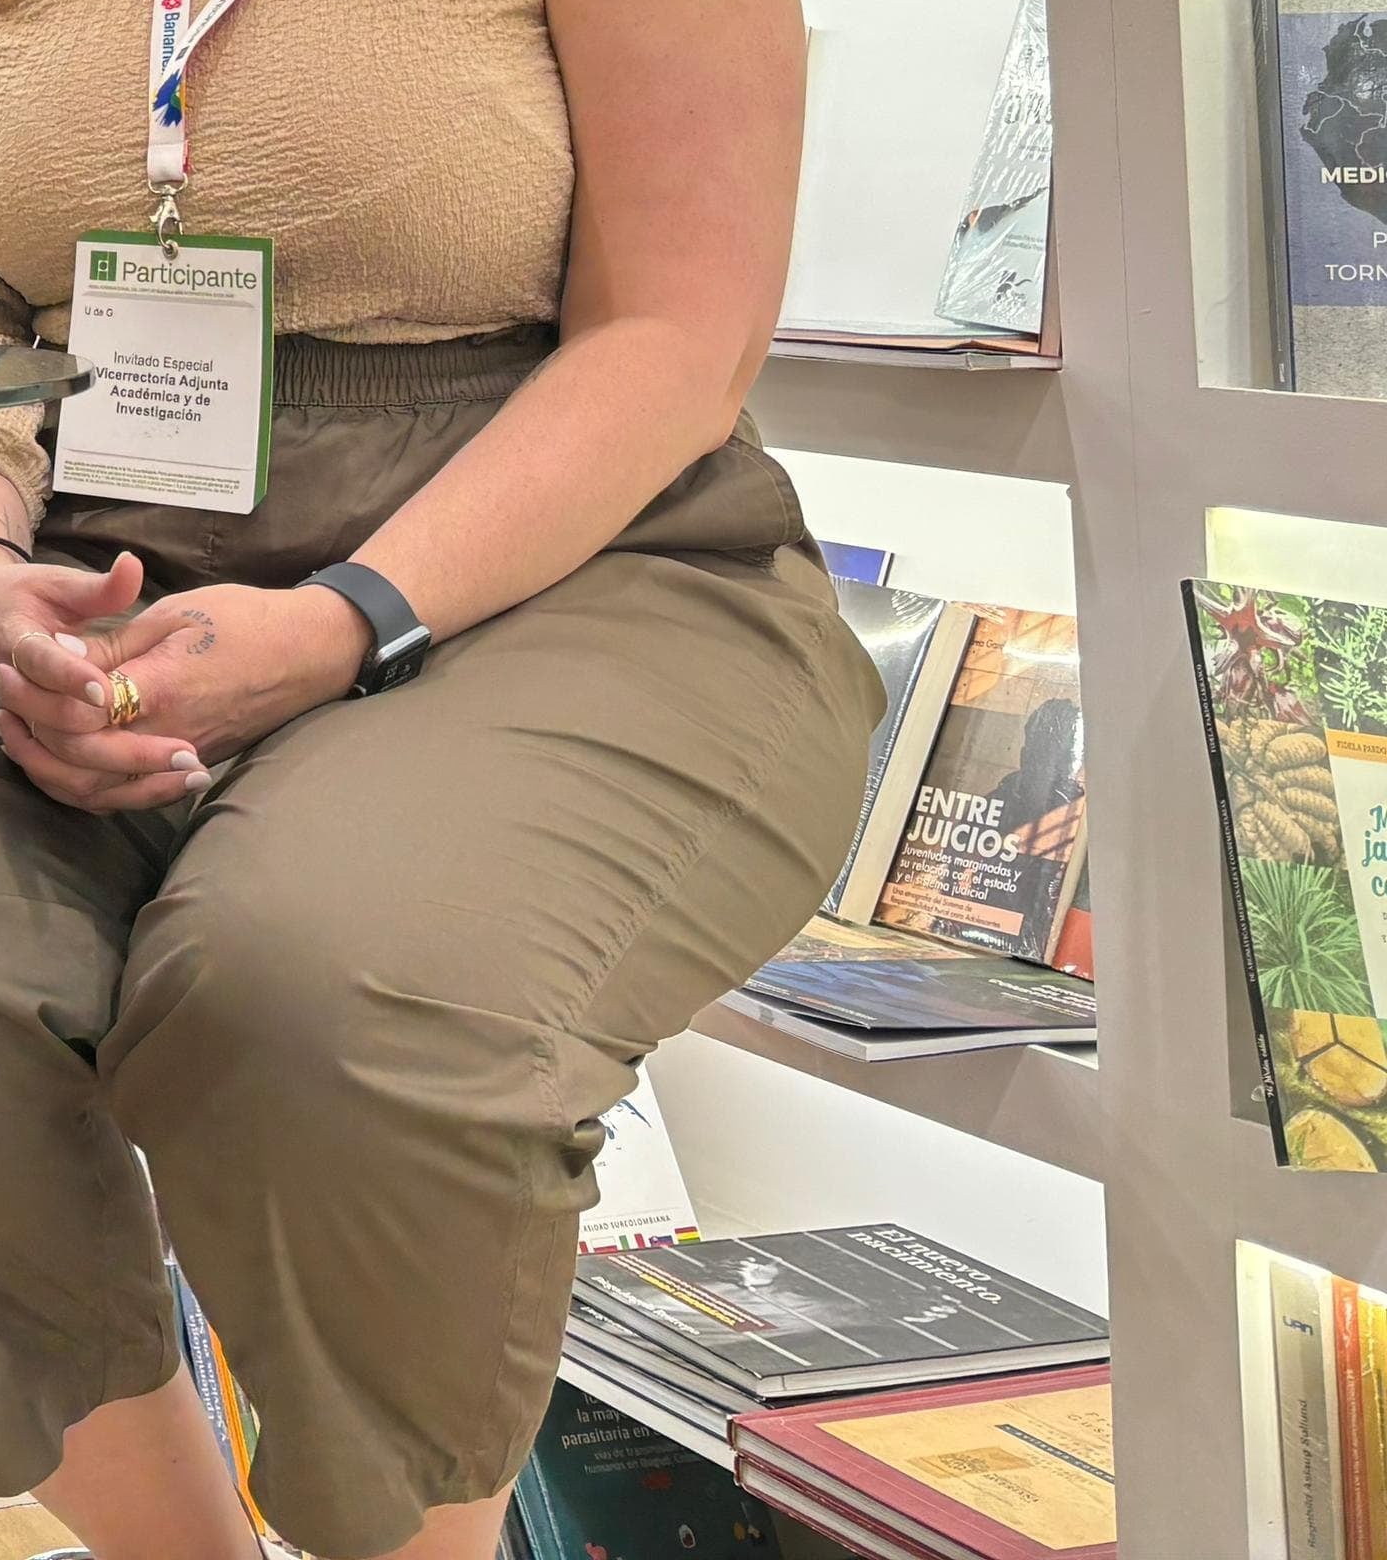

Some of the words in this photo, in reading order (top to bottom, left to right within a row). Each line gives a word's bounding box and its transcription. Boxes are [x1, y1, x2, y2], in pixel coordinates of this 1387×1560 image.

[122, 262, 257, 290] Participante
[85, 306, 91, 315] U
[93, 308, 104, 316] de
[106, 308, 113, 317] G
[114, 352, 159, 368] Invitado
[163, 356, 213, 372] Especial
[96, 367, 176, 386] Vicerrectoría
[179, 376, 229, 391] Adjunta
[110, 385, 180, 402] Académica
[184, 394, 192, 406] y
[195, 394, 211, 406] de
[117, 402, 202, 421] Investigación
[1337, 740, 1361, 752] FIDELA
[916, 786, 1004, 827] ENTRE
[907, 815, 1021, 862] JUICIOS
[902, 843, 952, 864] Juventudes
[954, 857, 1011, 877] marginadas
[1014, 870, 1022, 882] y
[895, 871, 902, 883] y
[905, 872, 914, 883] el
[916, 874, 949, 891] sistema
[952, 885, 988, 900] judicial
[900, 859, 910, 868] su
[912, 860, 949, 879] relación
[952, 870, 971, 882] con
[973, 875, 982, 886] el
[984, 879, 1016, 893] estado
[844, 1230, 1005, 1306] nacimiento.
[904, 1237, 994, 1283] nuevo
[577, 1408, 590, 1423] la
[561, 1428, 629, 1449] parasitaria
[633, 1427, 650, 1438] en
